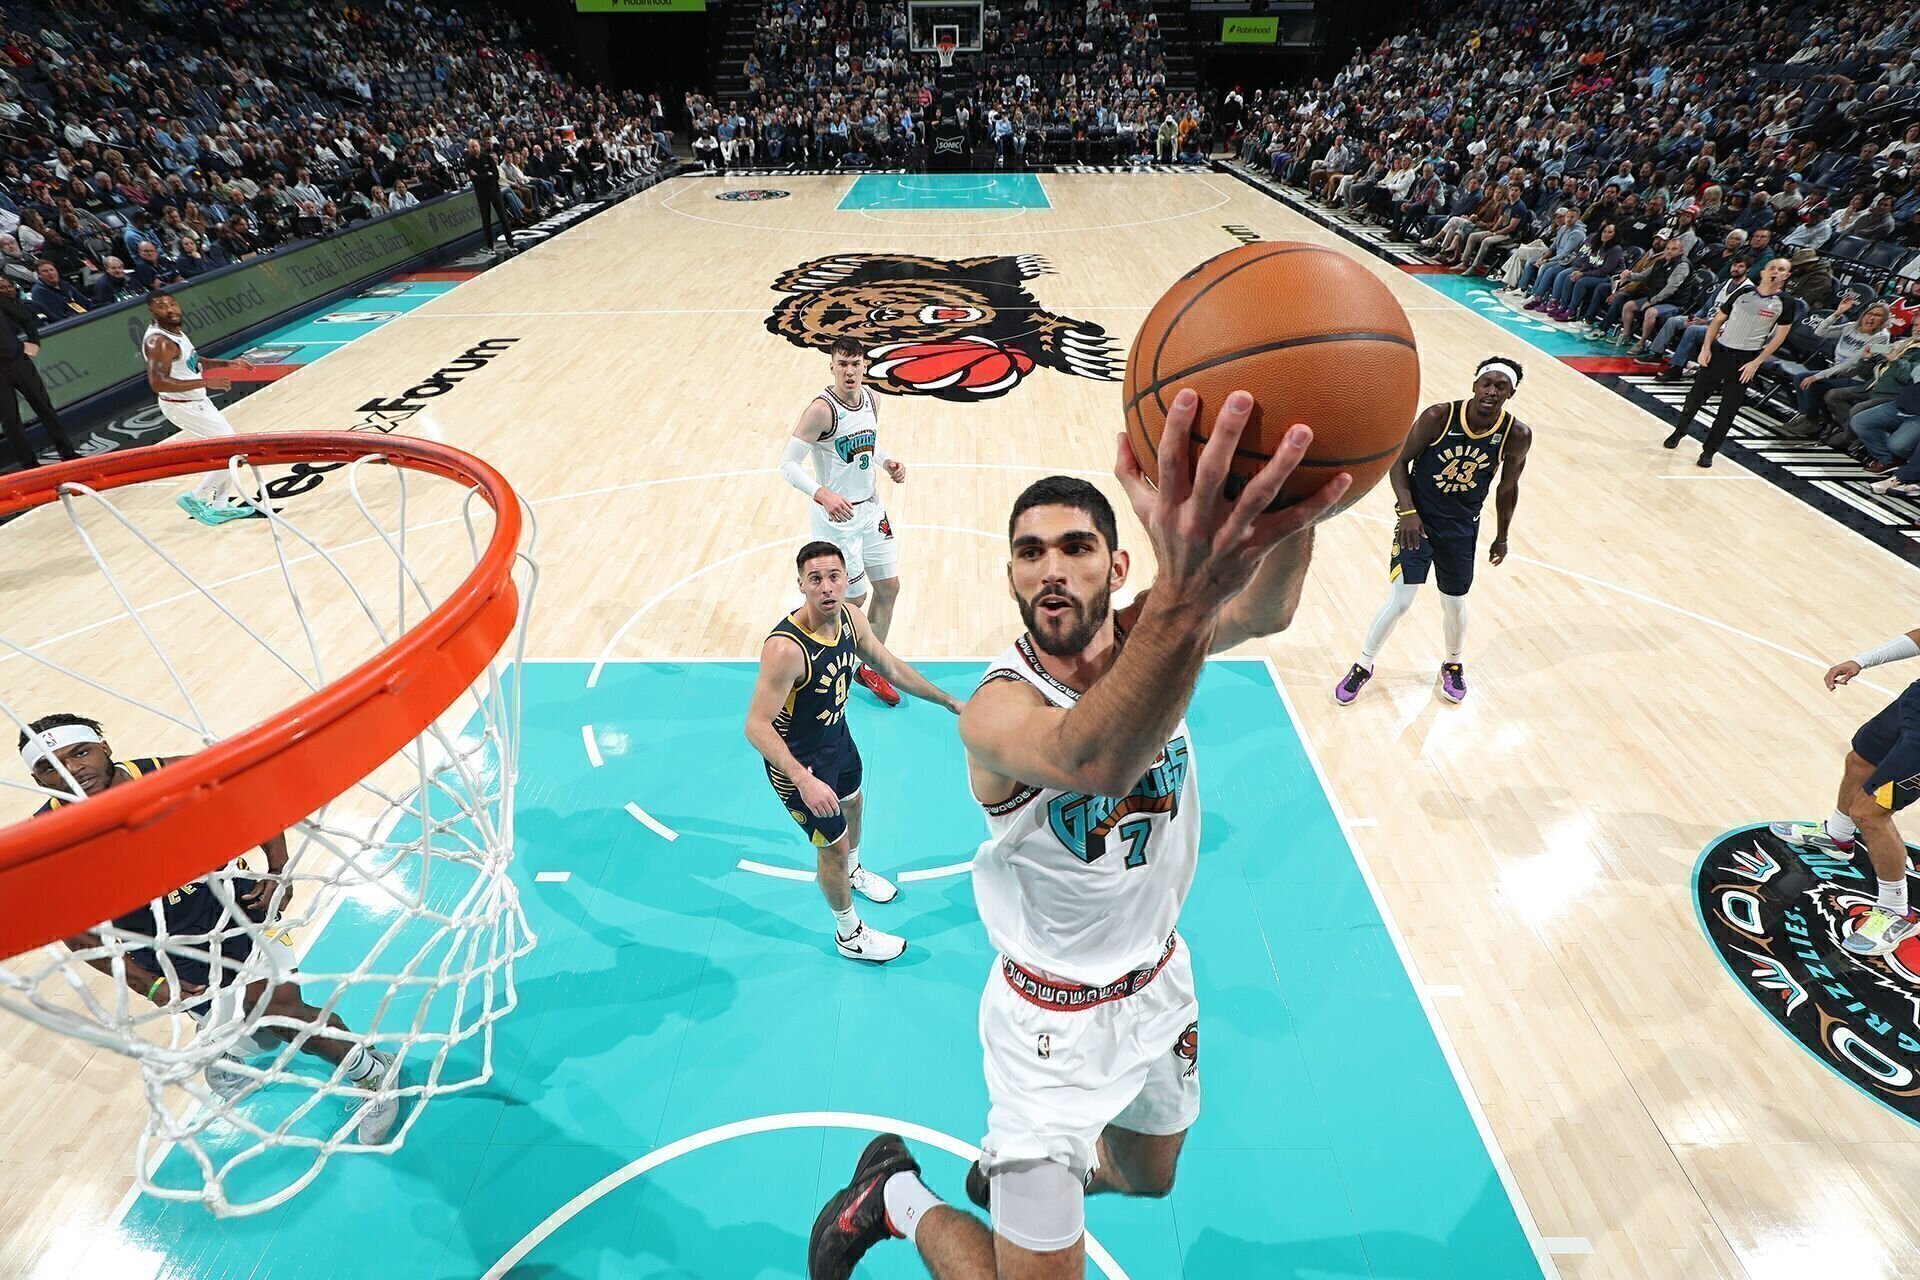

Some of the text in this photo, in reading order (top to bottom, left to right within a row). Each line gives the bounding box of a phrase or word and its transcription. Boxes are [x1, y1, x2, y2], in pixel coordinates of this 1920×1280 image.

[1236, 26, 1271, 34] Robinhood
[938, 141, 960, 149] SONIC
[182, 281, 265, 334] binhood
[859, 454, 869, 470] 3
[1437, 445, 1490, 470] INDIANA
[1433, 473, 1478, 493] PACERS
[1441, 458, 1478, 483] 43
[835, 673, 847, 707] 9
[1119, 817, 1153, 870] 7
